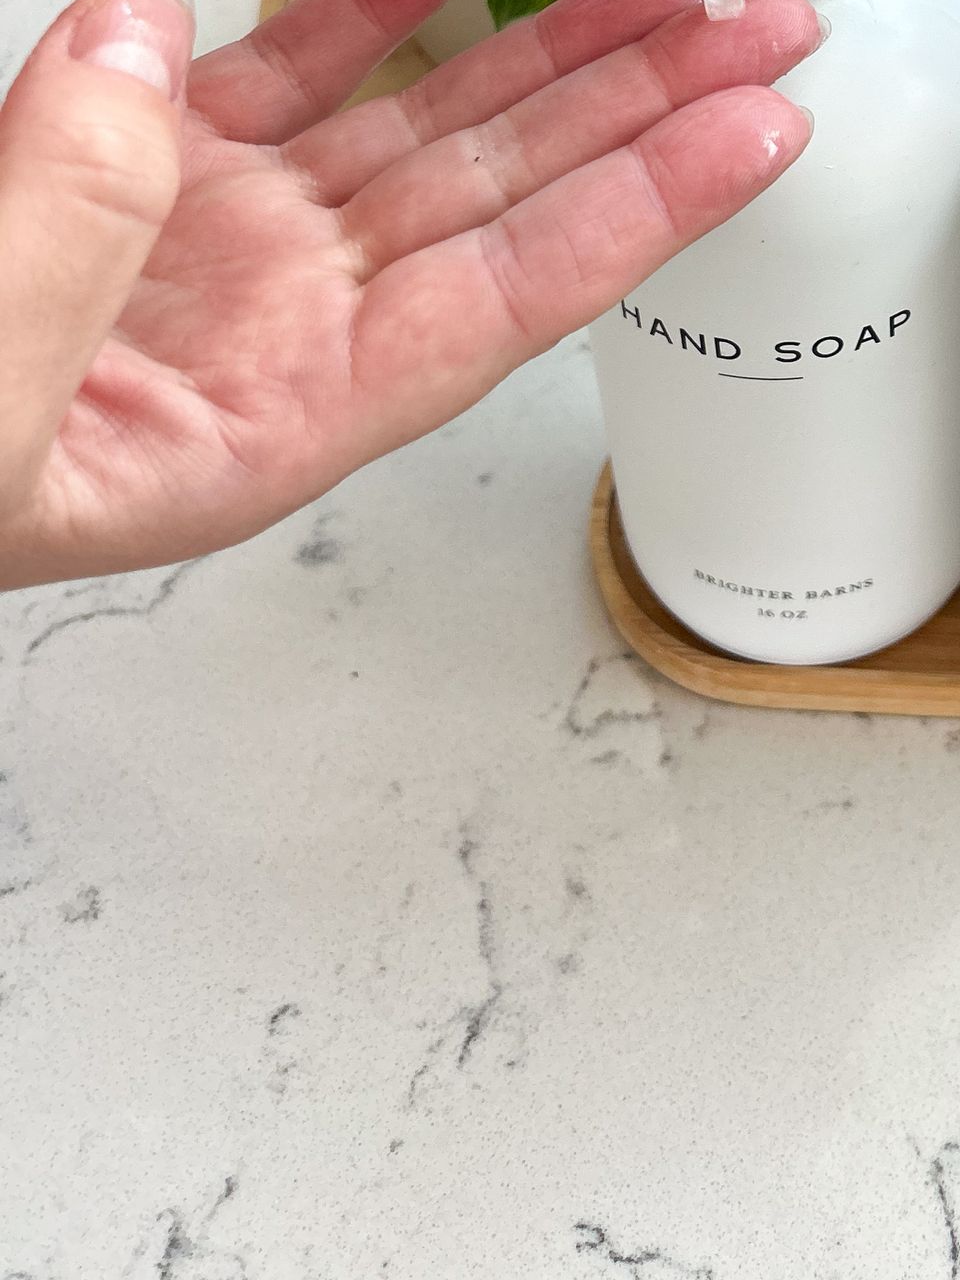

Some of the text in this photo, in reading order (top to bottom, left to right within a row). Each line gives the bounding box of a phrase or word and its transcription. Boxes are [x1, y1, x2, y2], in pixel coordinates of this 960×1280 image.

[620, 298, 911, 363] HAND SOAP
[694, 568, 874, 600] BRIGHTER BARNS
[757, 608, 808, 620] 16 OZ
